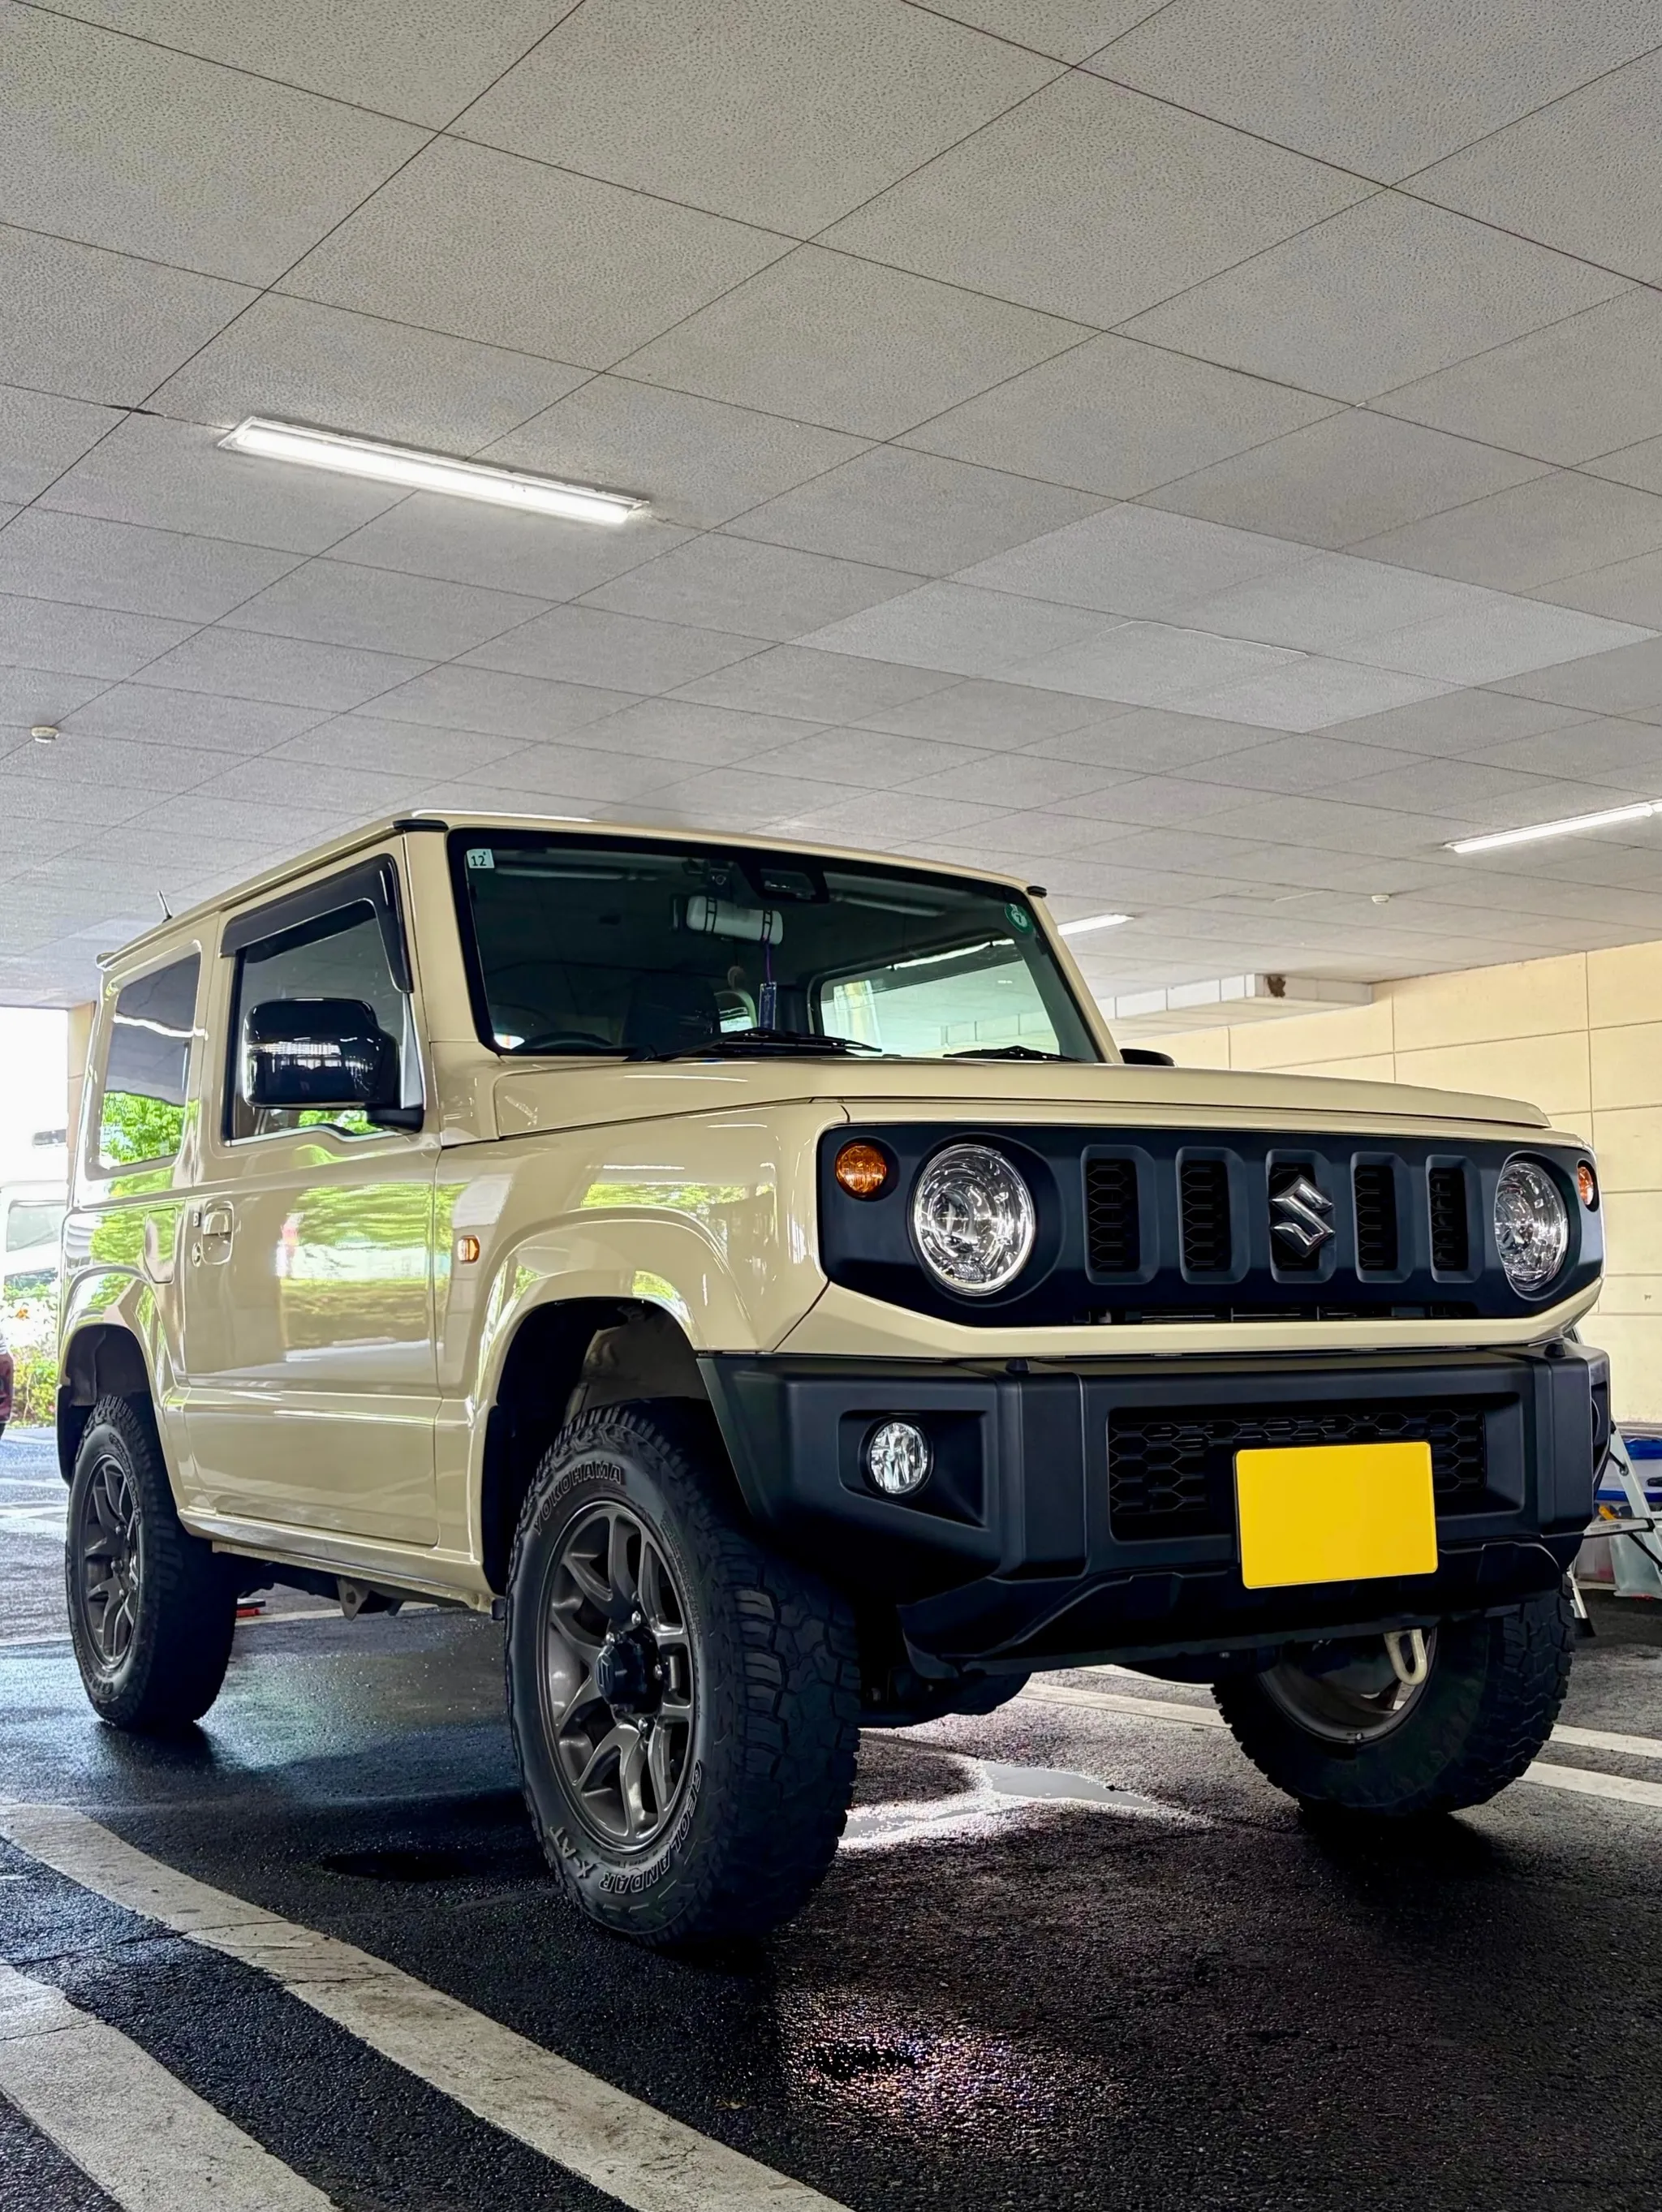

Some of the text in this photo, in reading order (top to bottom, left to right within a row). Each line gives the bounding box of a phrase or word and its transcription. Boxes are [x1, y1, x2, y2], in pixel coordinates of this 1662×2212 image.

[471, 855, 487, 867] 12
[533, 1461, 622, 1536] YOKOHAMA
[549, 1759, 702, 1894] GEOLANDAR X-AT
